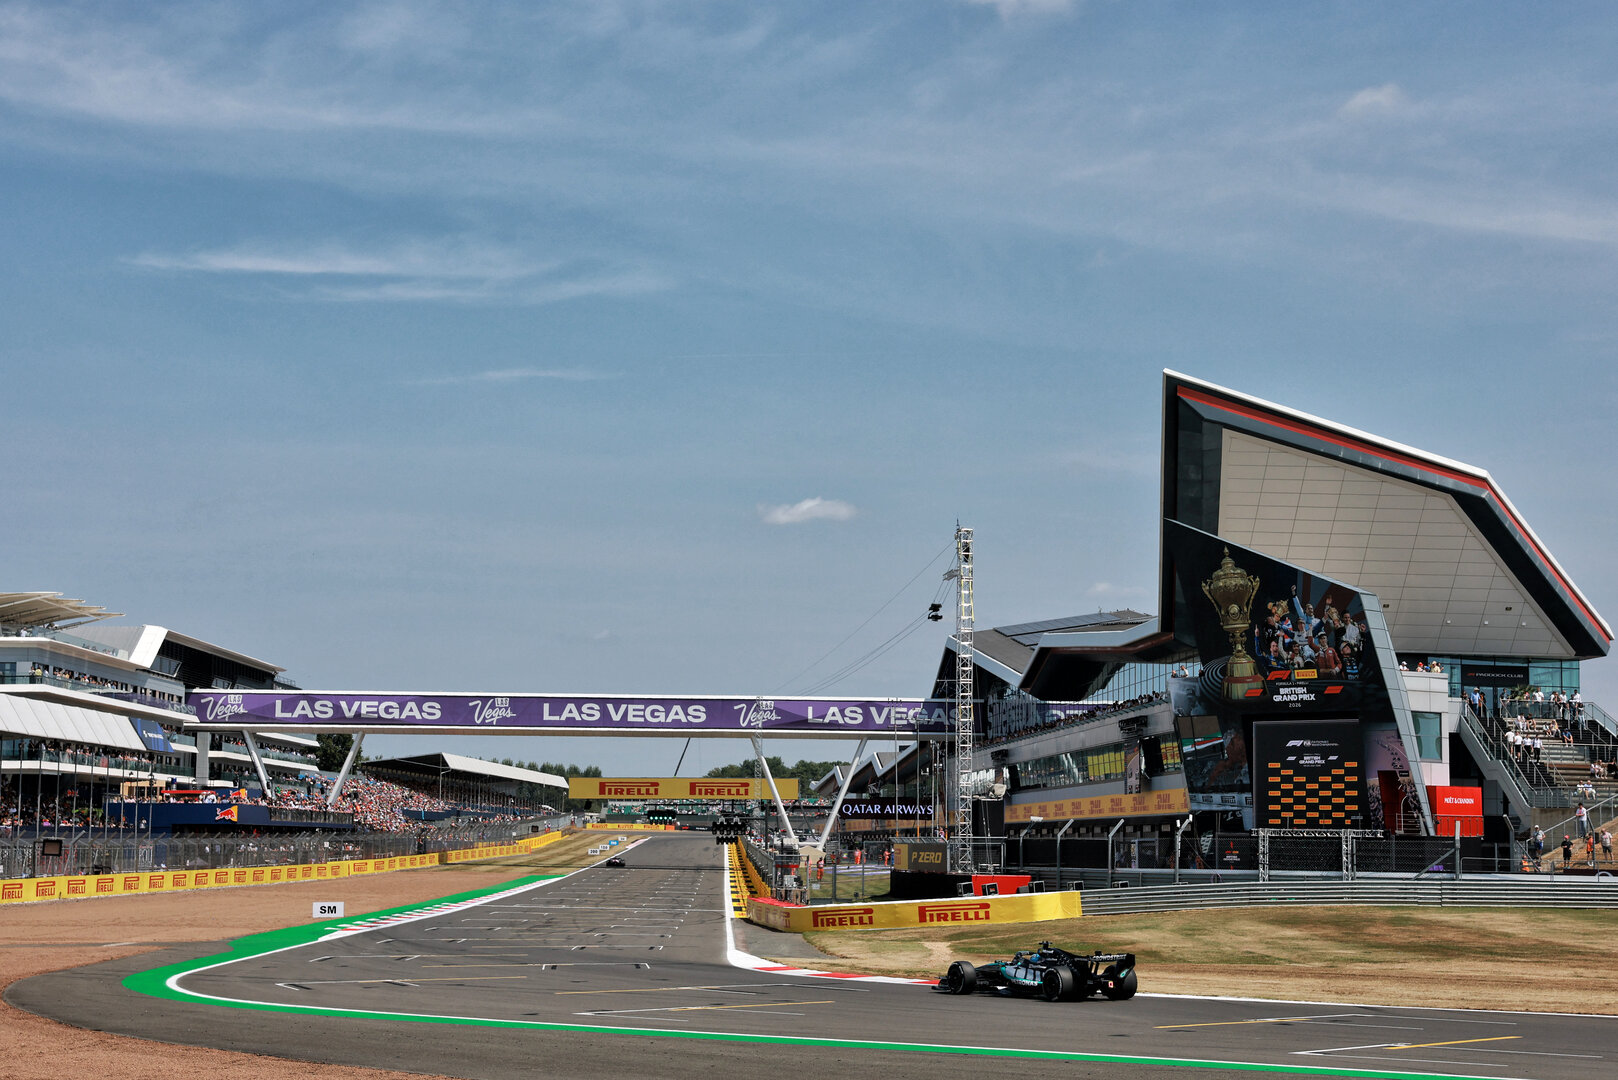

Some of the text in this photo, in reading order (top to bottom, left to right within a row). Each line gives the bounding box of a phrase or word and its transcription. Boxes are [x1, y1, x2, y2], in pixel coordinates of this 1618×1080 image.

[228, 695, 242, 703] LAS
[495, 698, 509, 706] LAS
[1273, 694, 1297, 702] GRAND
[201, 696, 248, 721] Vegas
[275, 699, 442, 720] LAS VEGAS
[469, 699, 516, 725] Vegas
[543, 702, 707, 723] LAS VEGAS
[734, 702, 781, 727] Vegas
[807, 706, 863, 725] LAS
[598, 782, 660, 796] PIRELLI
[689, 782, 750, 796] PIRELLI
[842, 803, 934, 816] QATAR AIRWAYS
[912, 852, 917, 862] P
[918, 851, 943, 863] ZERO
[96, 878, 114, 892] PIRELLI
[124, 876, 140, 890] PIRELLI
[149, 875, 164, 889] PIRELLI
[173, 873, 187, 887] PIRELLI
[195, 872, 208, 886] PIRELLI
[2, 883, 23, 900] PIRELLI
[36, 881, 56, 897] PIRELLI
[67, 879, 86, 894] PIRELLI
[319, 905, 337, 914] SM
[918, 903, 991, 923] PIRELLI
[812, 908, 874, 928] PIRELLI
